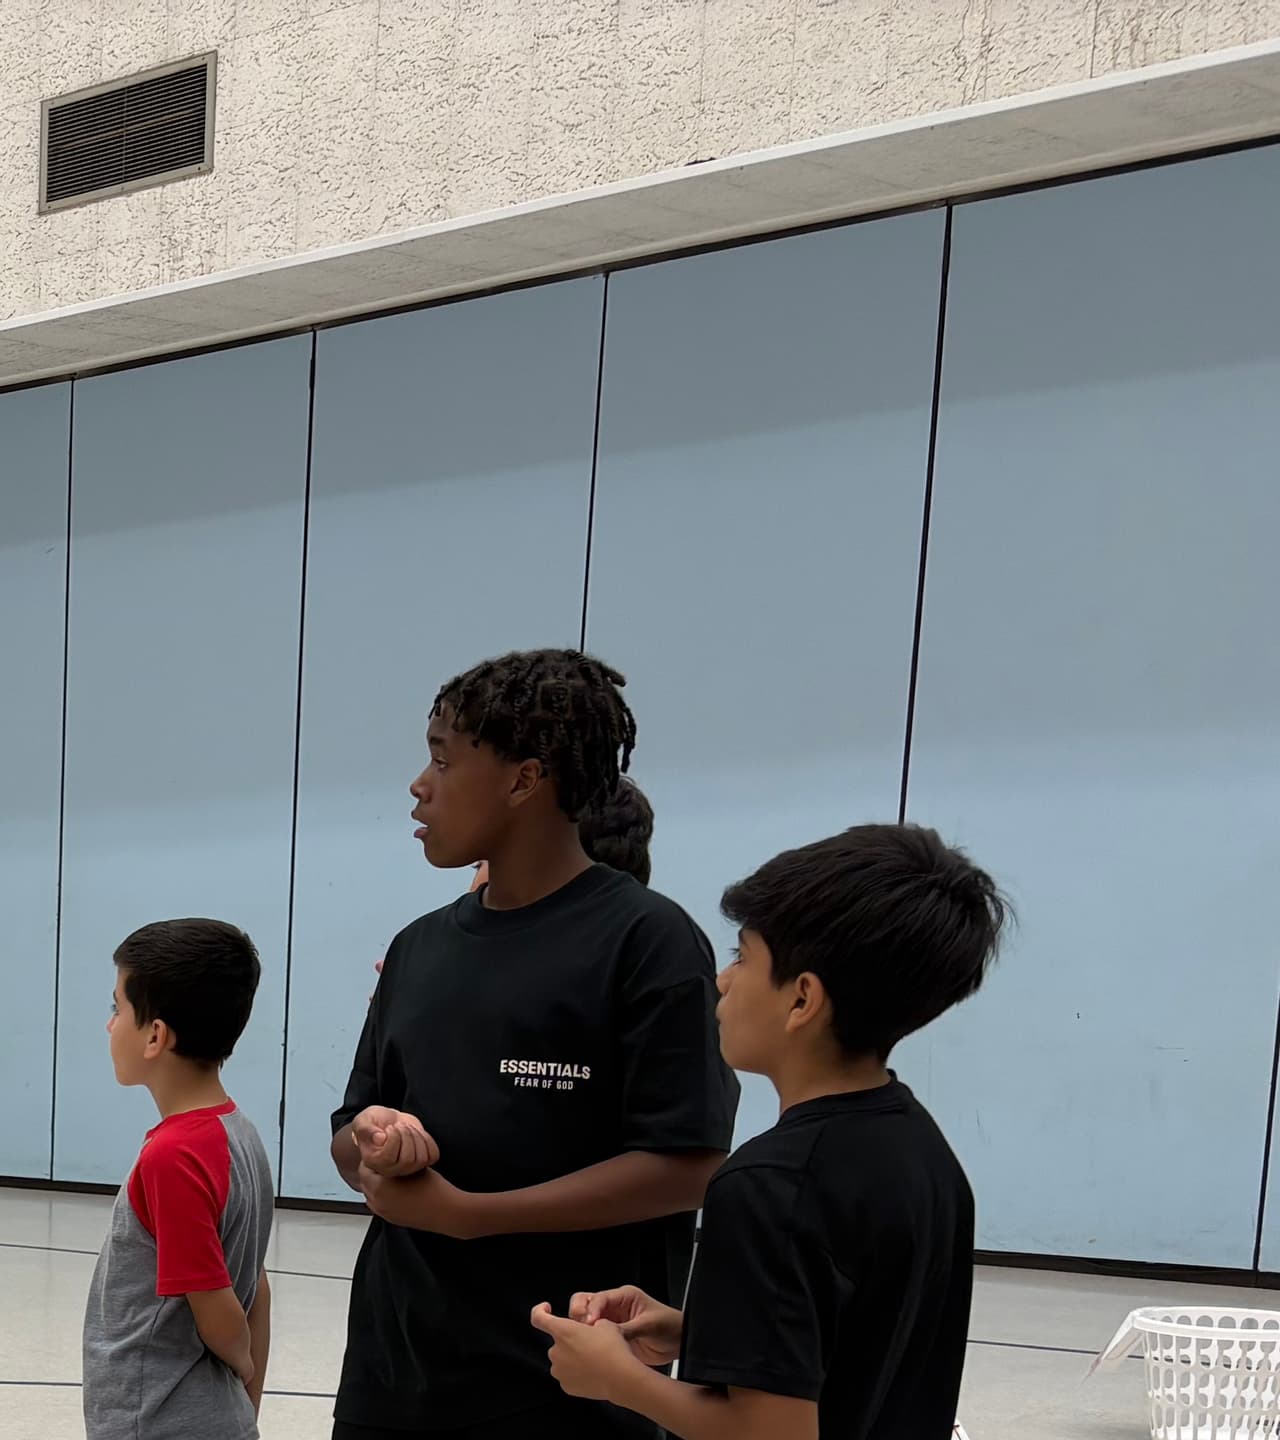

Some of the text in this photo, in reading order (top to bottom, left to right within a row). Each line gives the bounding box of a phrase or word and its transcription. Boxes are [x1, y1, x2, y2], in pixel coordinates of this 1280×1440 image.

[500, 1059, 591, 1079] ESSENTIALS
[514, 1077, 573, 1090] FEAR OF GOD
